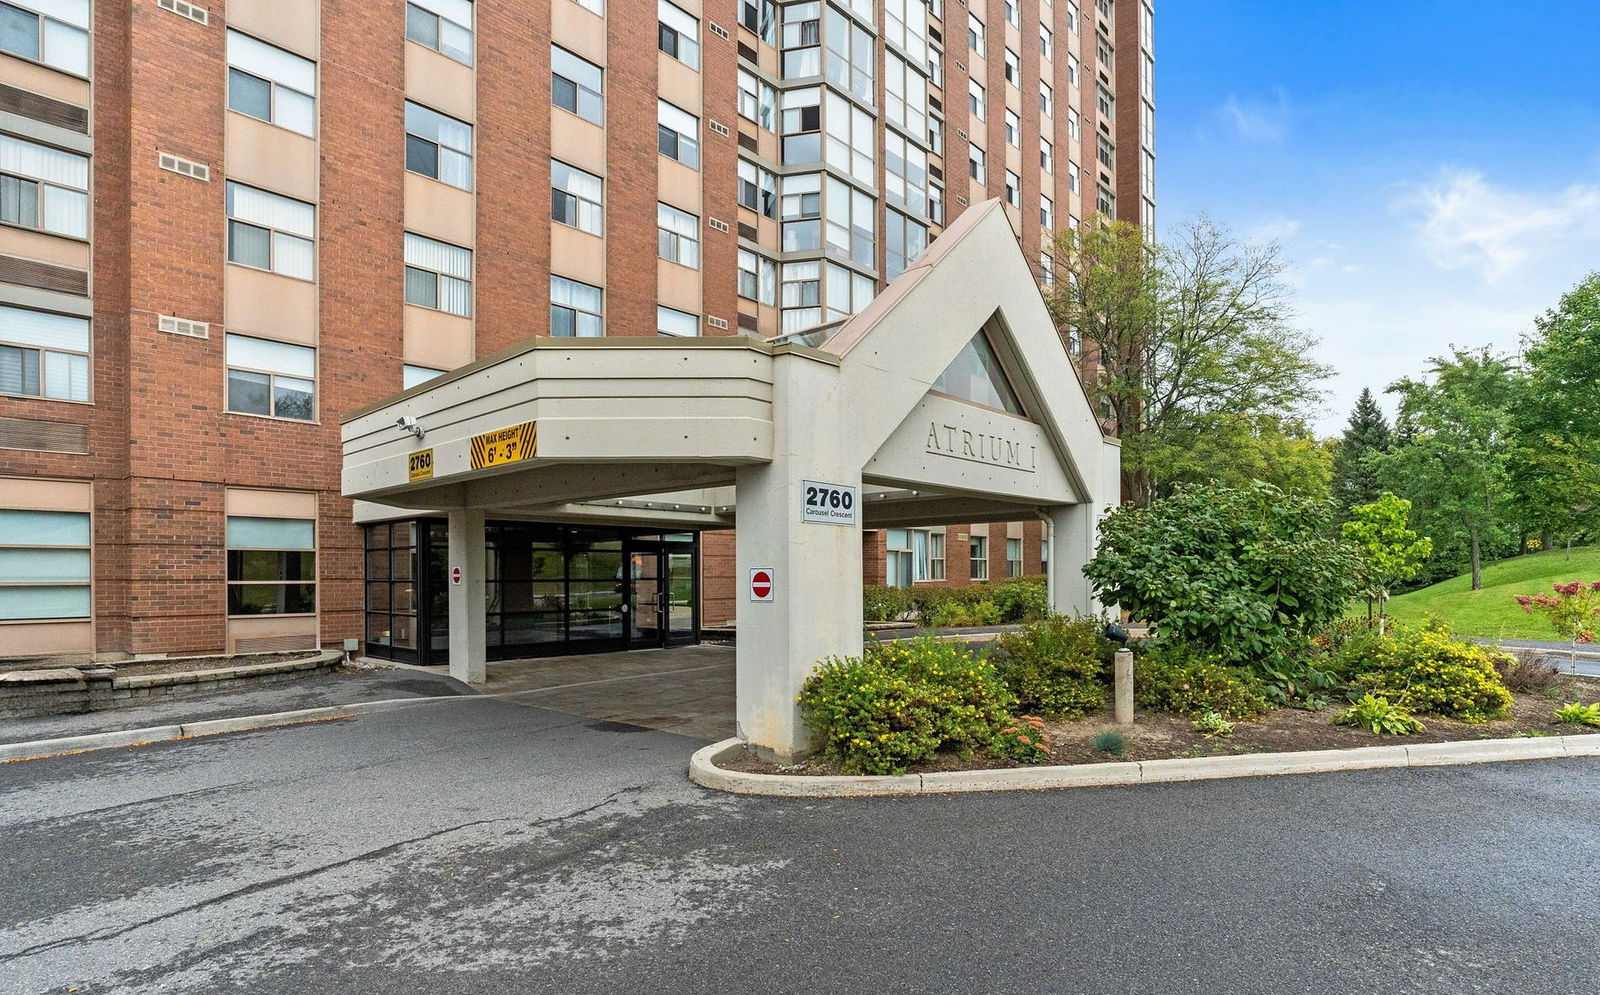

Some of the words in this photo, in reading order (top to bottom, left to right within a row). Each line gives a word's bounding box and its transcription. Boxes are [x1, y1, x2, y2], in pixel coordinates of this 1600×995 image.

[486, 433, 498, 445] MAX
[498, 428, 519, 442] HEIGHT
[927, 421, 1020, 465] ATRIUM
[1030, 445, 1036, 469] I
[410, 453, 431, 471] 2760
[806, 486, 853, 510] 2760
[806, 508, 829, 517] Carousel
[830, 510, 853, 519] Crescent
